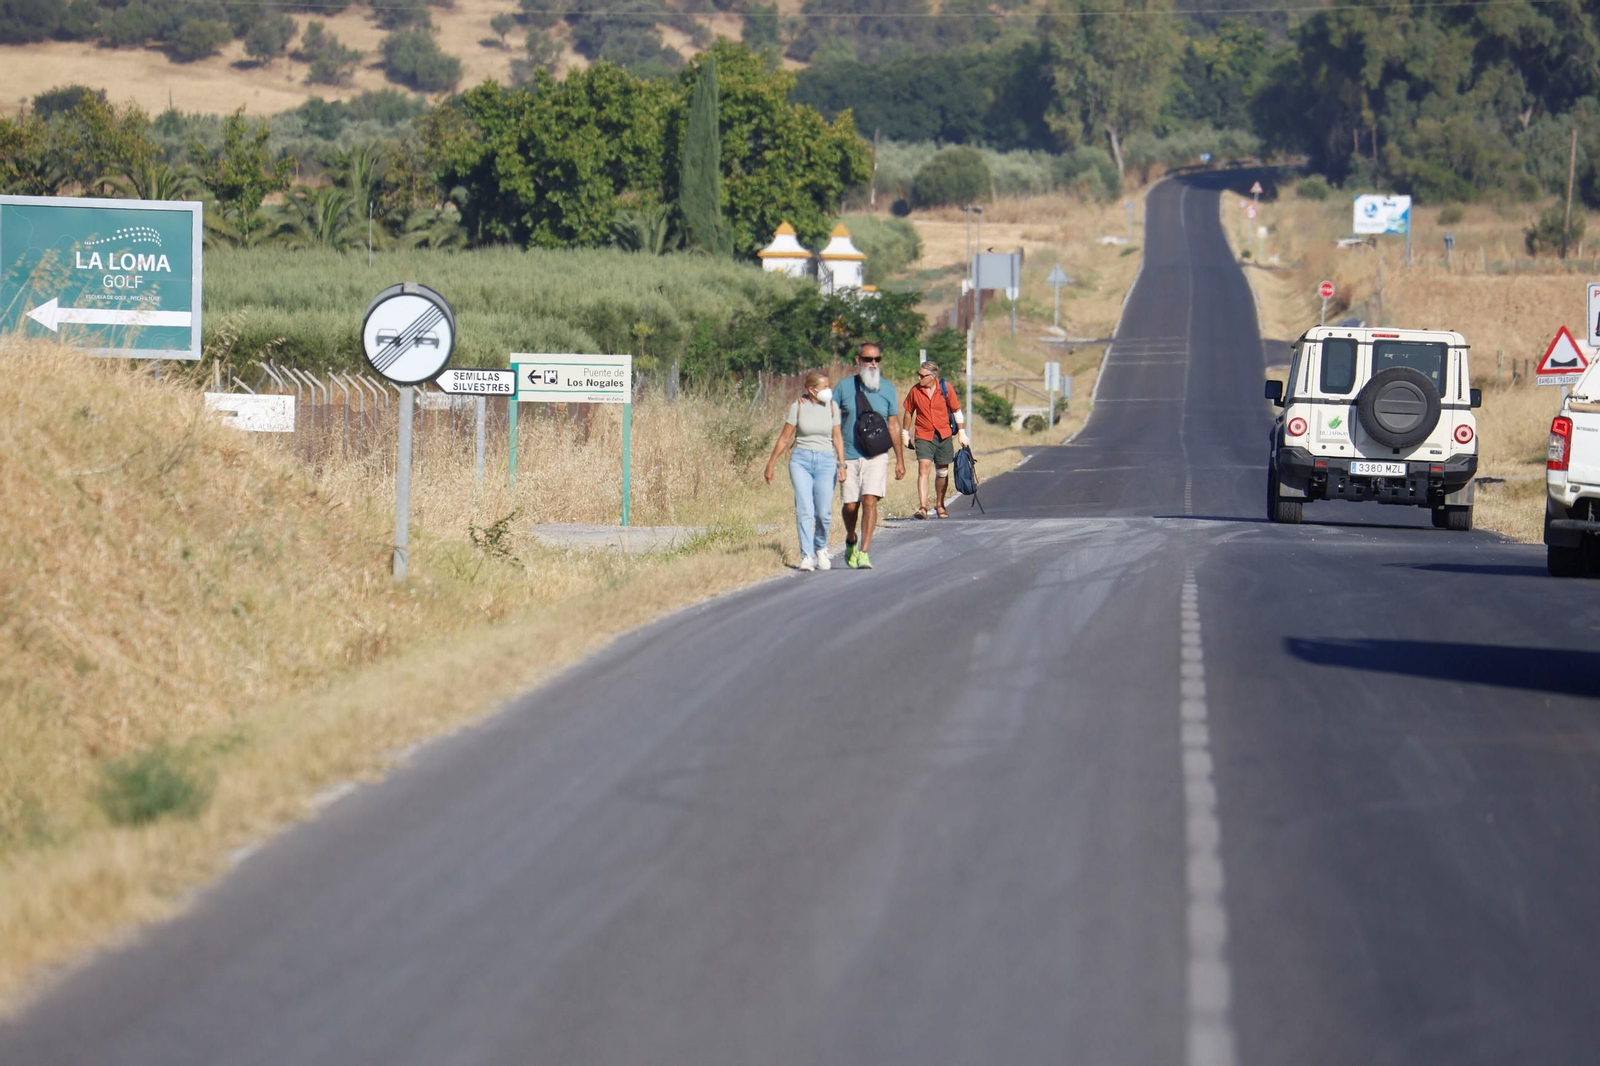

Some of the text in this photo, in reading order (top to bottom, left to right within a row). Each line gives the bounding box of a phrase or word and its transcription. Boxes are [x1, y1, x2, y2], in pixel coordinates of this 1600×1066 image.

[75, 251, 172, 273] LA LOMA
[102, 274, 144, 289] GOLF
[453, 371, 500, 382] SEMILLAS
[583, 367, 625, 378] Puente de
[453, 382, 510, 392] SILVESTRES
[567, 378, 624, 389] Los Nogales
[1358, 463, 1403, 474] 3380 MZL
